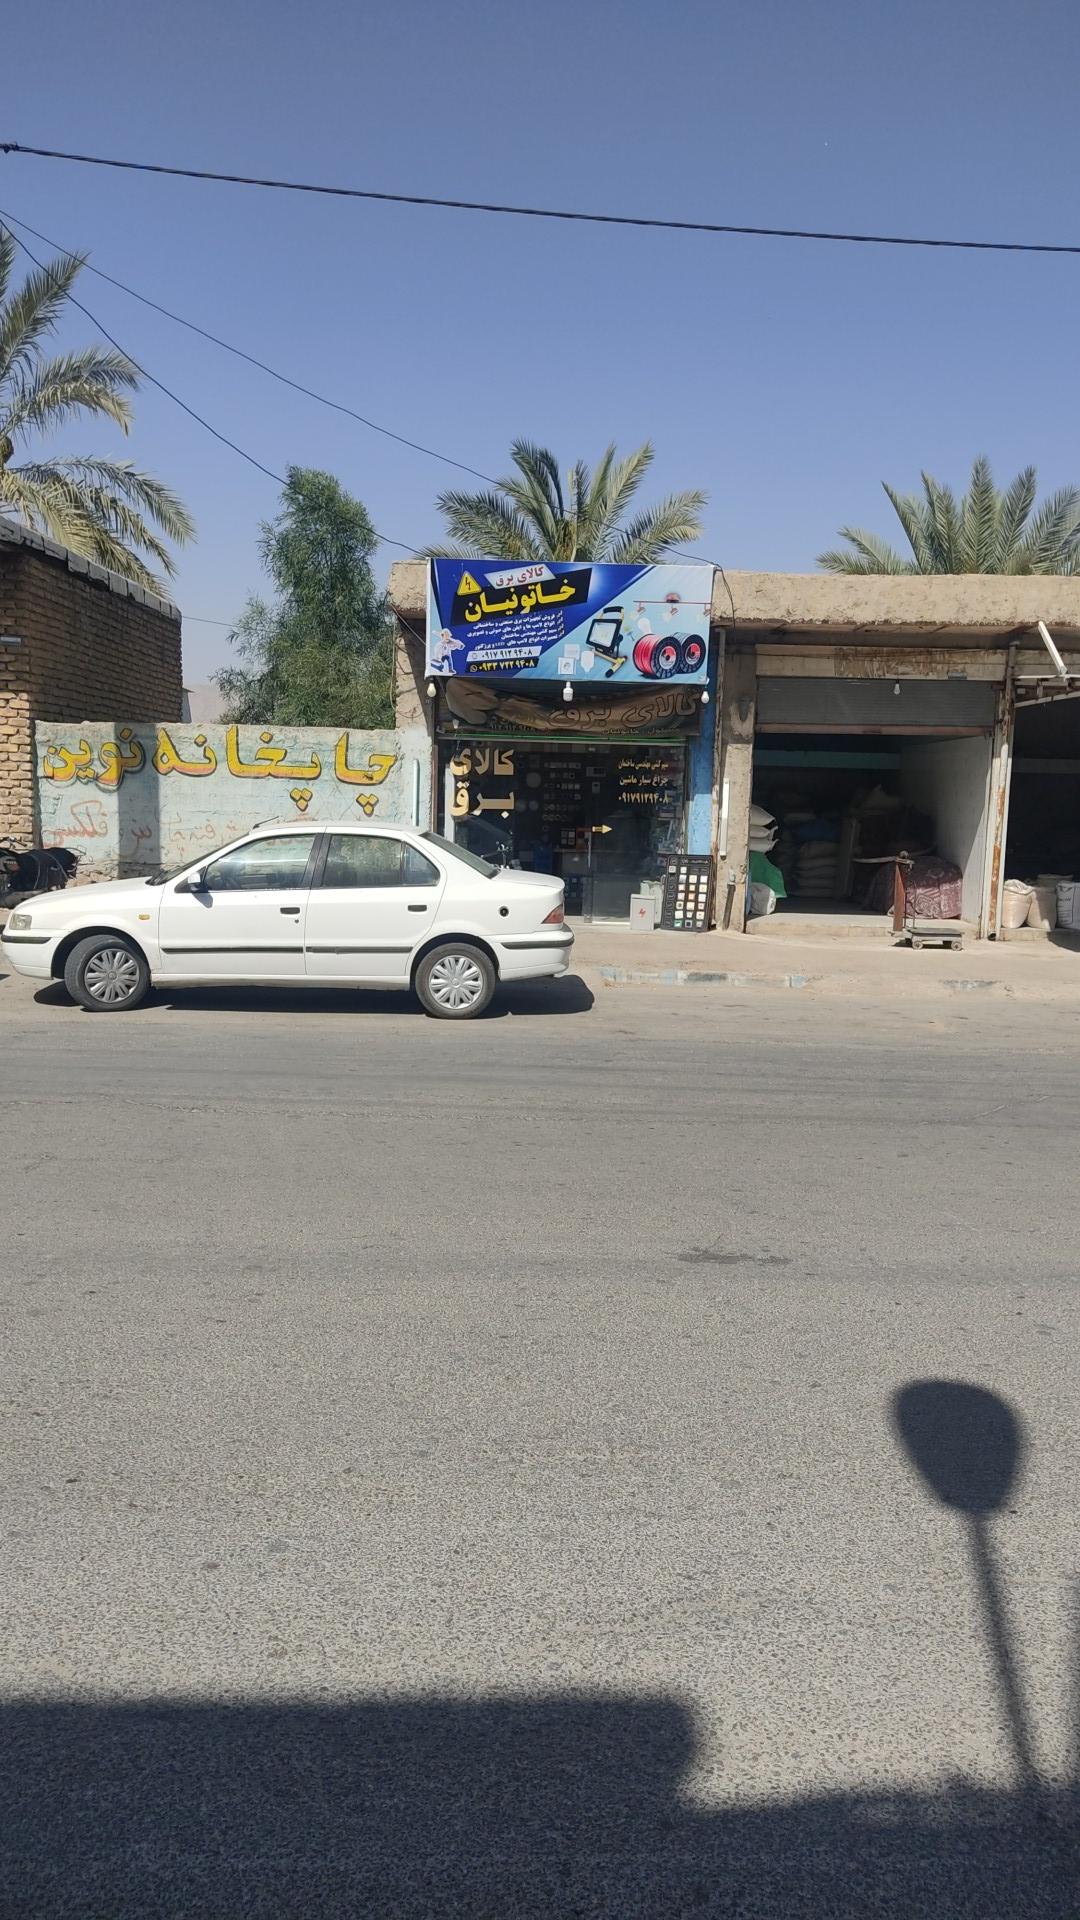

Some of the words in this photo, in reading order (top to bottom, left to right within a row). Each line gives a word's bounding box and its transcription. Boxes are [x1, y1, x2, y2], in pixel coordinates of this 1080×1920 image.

[496, 574, 514, 587] برق
[517, 566, 545, 583] کالای
[465, 578, 576, 622] خاتونیان
[548, 704, 610, 729] برق
[622, 691, 699, 727] کالای
[44, 727, 145, 786] نوین
[450, 748, 514, 776] کالای
[153, 724, 399, 816] چاپخانه
[619, 774, 637, 786] ماشین
[638, 774, 652, 786] سیار
[652, 774, 669, 787] چراغ
[447, 781, 514, 819] برق
